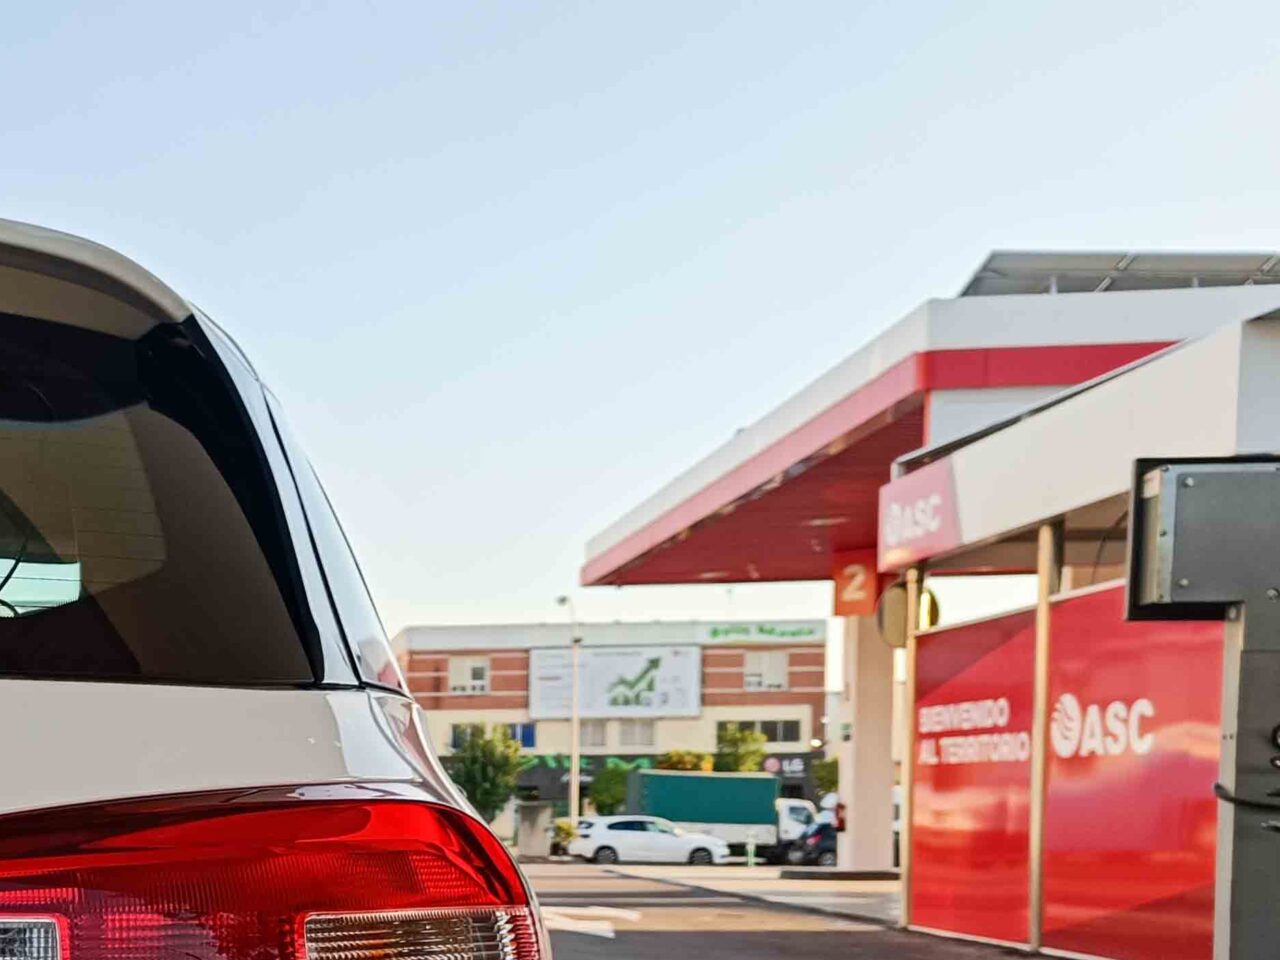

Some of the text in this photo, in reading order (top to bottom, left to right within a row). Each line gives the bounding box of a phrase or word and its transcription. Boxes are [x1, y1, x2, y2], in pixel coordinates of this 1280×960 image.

[841, 564, 867, 602] 2
[919, 698, 1009, 733] BIENVENIDO
[918, 732, 1030, 764] AL TERRITORIO
